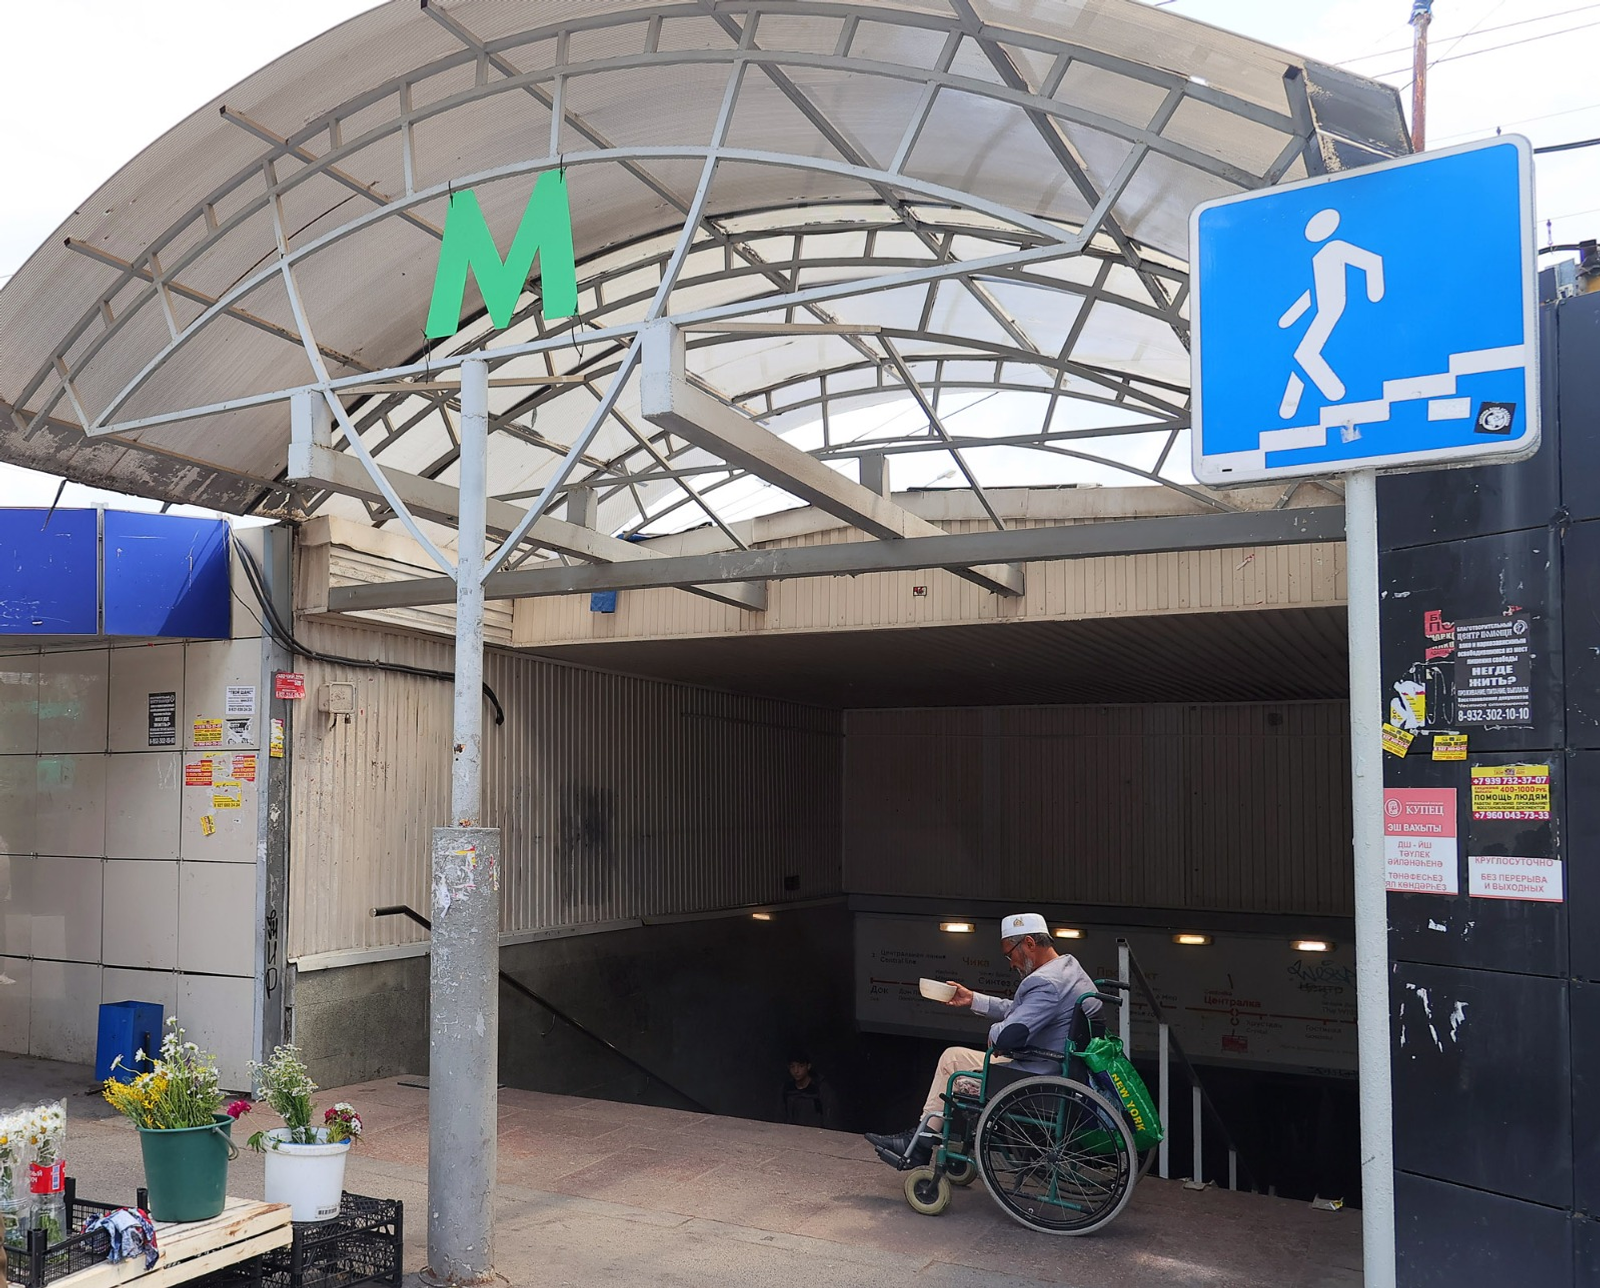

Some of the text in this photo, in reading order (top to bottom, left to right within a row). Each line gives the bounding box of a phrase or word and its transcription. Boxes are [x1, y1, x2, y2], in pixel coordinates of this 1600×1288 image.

[1471, 665, 1514, 676] НЕГДЕ
[1469, 676, 1517, 688] ЖИТЬ?
[1457, 707, 1529, 722] 8-932-302-10-10
[1485, 777, 1502, 785] 939
[1502, 776, 1547, 784] 732-37-07
[1405, 805, 1444, 816] КУПЕЦ
[1486, 811, 1503, 819] 960
[1504, 811, 1550, 819] 043-73-33
[1387, 823, 1402, 832] ЭШ
[1398, 841, 1412, 849] ДШ
[1474, 856, 1554, 867] КРУГЛОСУТОЧНО
[1481, 873, 1548, 883] БЕЗ ПЕРЕРЫВА
[1492, 883, 1544, 892] ВЫХОДНЫХ
[870, 985, 889, 995] Док
[1204, 995, 1262, 1008] Централка
[1111, 1073, 1146, 1131] NEW YORK
